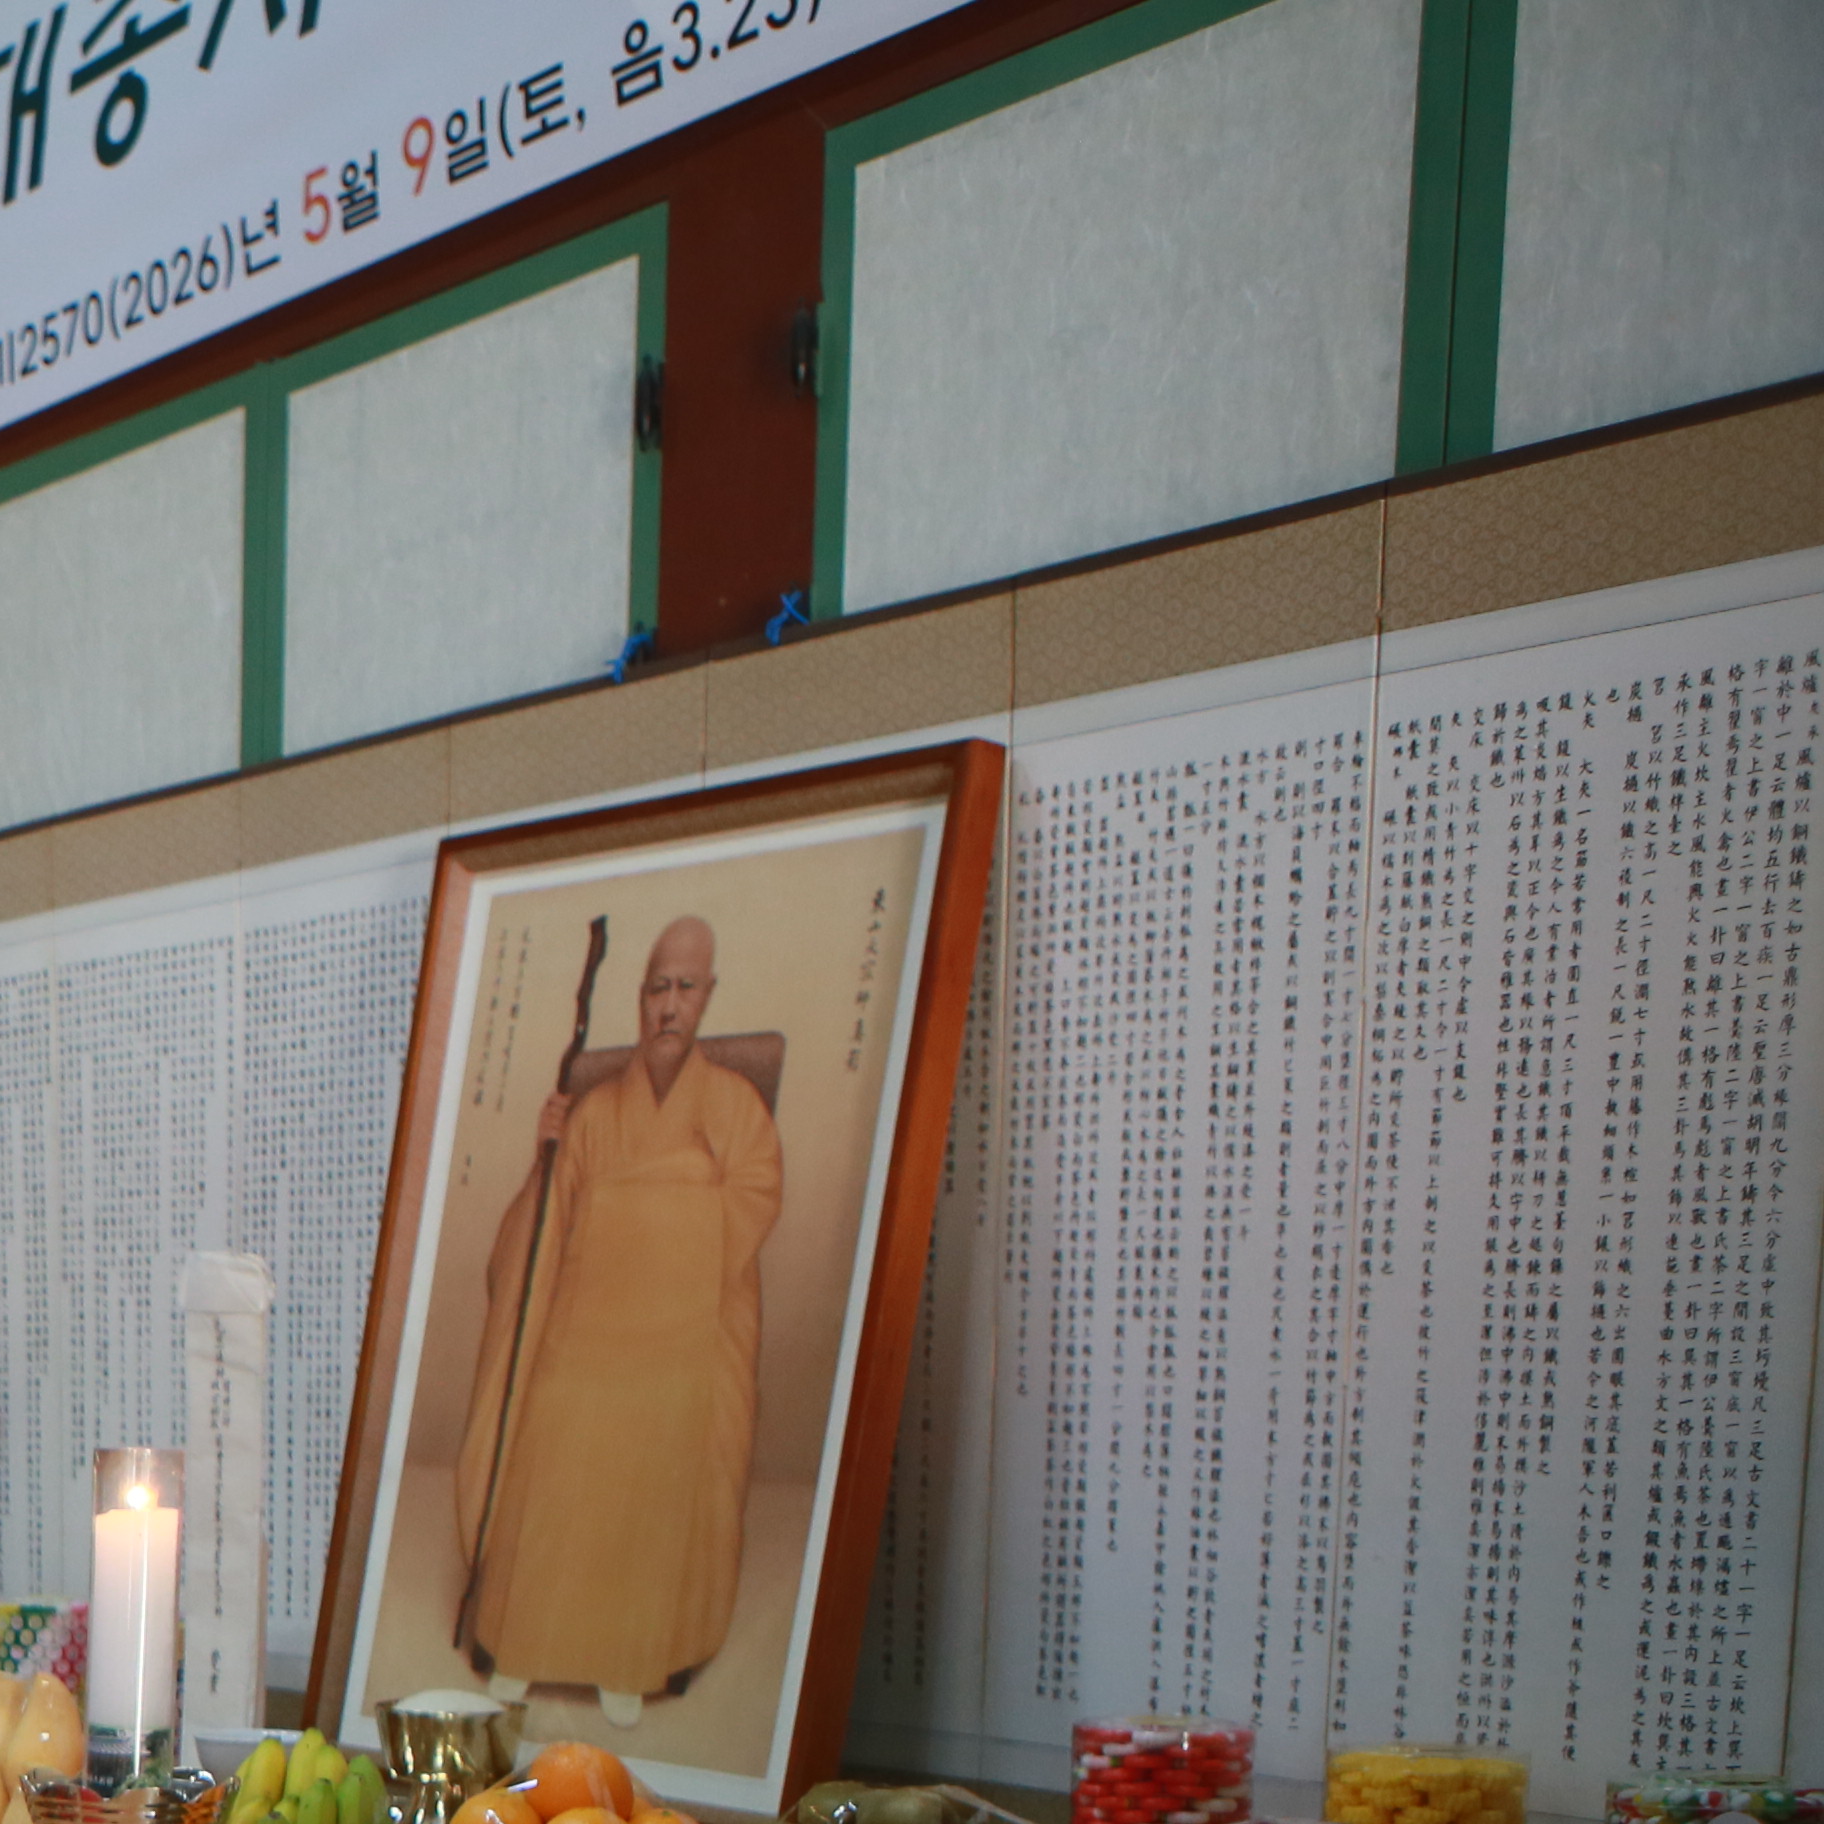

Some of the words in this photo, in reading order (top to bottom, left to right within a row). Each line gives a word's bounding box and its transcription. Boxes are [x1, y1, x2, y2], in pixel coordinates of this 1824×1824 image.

[301, 149, 380, 246] 5월
[401, 62, 588, 197] 9일(토,
[1605, 687, 1620, 703] 也
